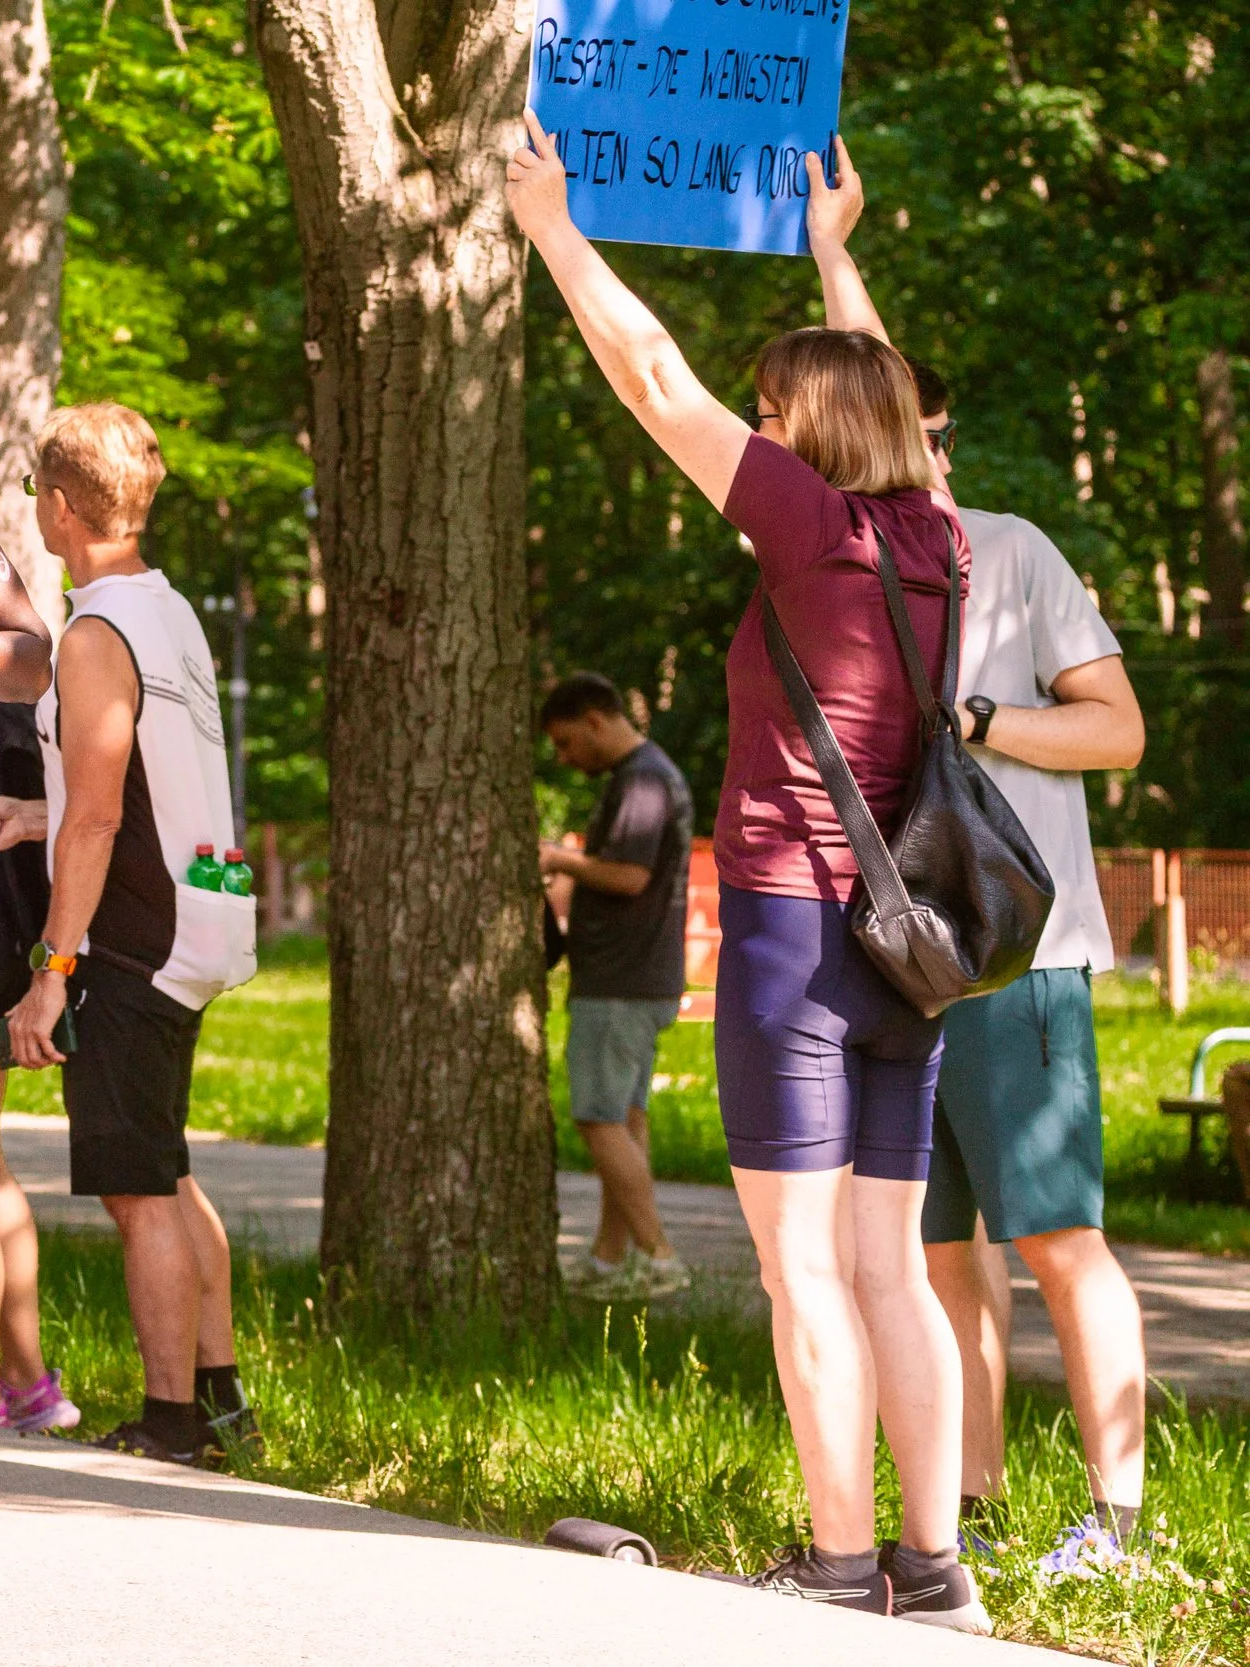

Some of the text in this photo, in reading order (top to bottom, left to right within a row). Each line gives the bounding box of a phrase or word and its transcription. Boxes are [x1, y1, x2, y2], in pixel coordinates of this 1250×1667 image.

[537, 17, 637, 92] RESPEKT
[648, 45, 689, 98] DIE
[699, 48, 810, 107] WENIGSTEN
[643, 135, 680, 188] SO
[688, 138, 747, 194] LANG
